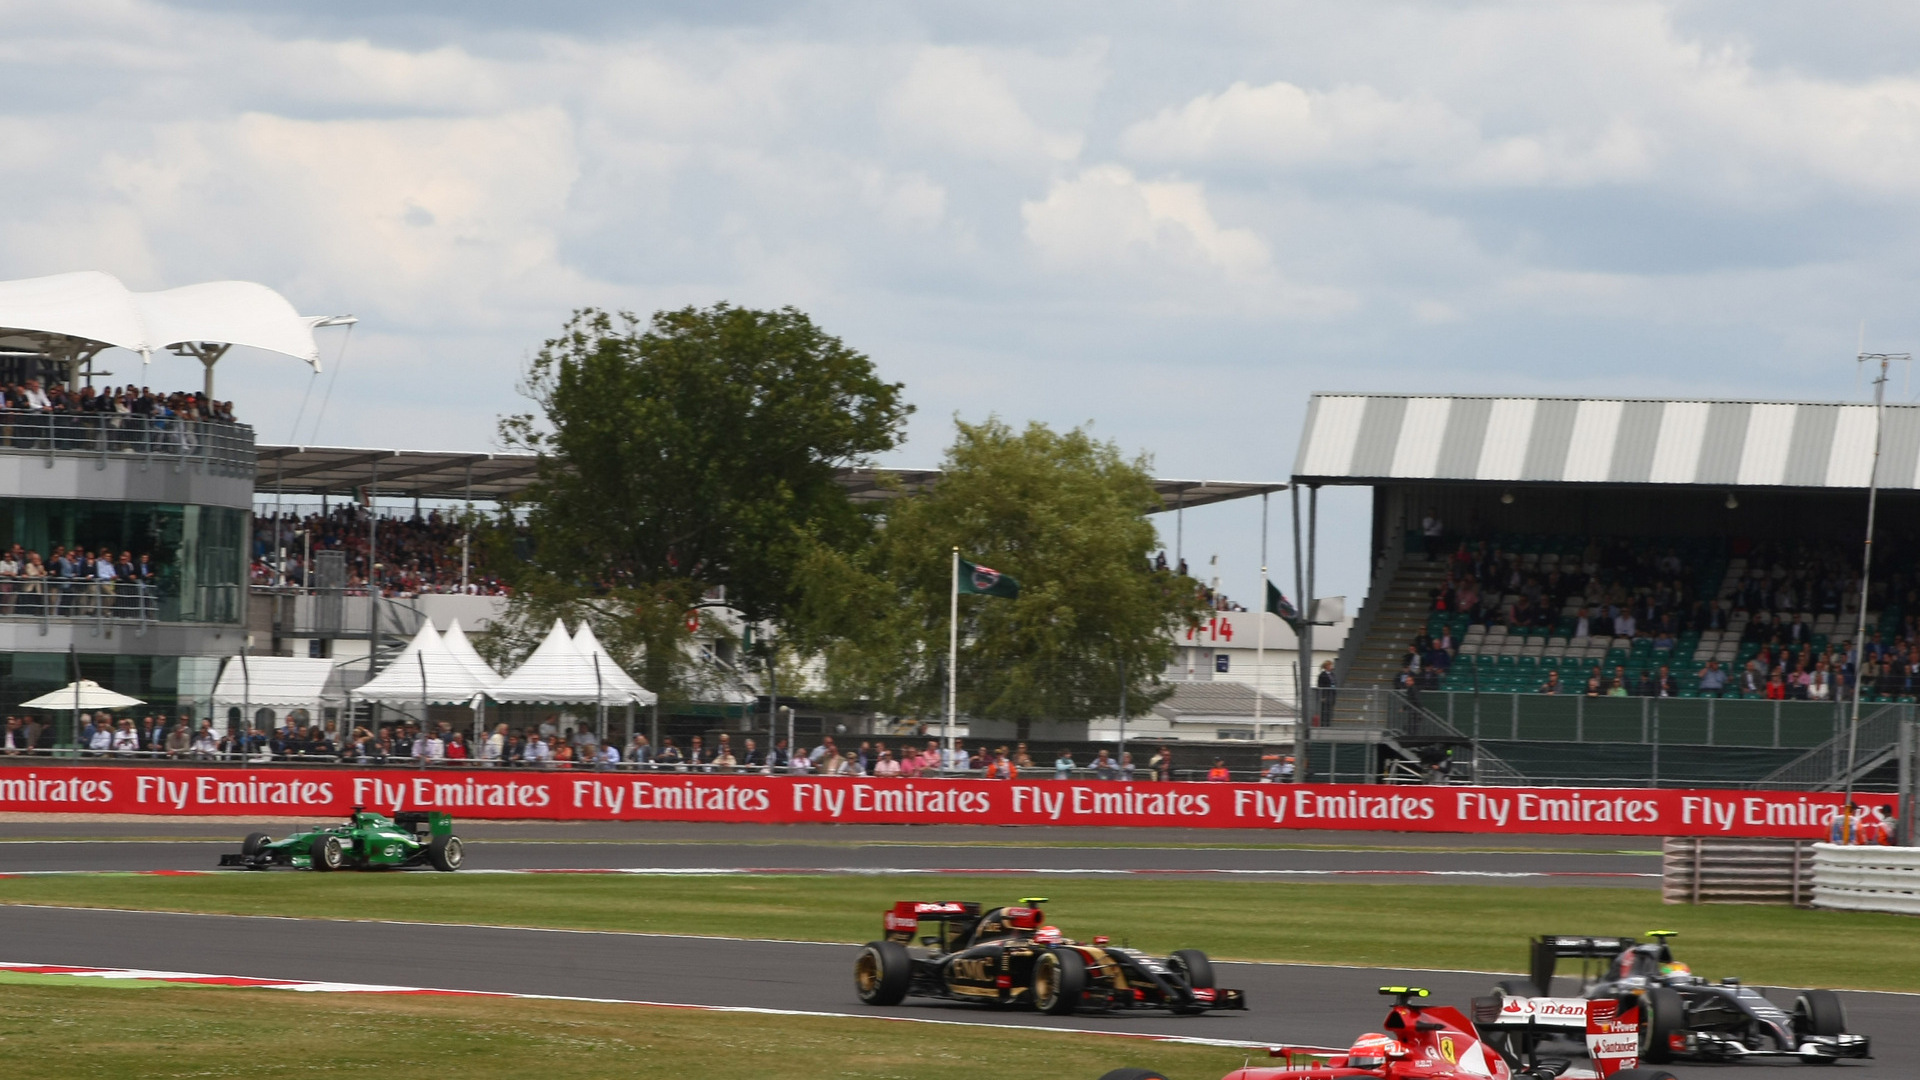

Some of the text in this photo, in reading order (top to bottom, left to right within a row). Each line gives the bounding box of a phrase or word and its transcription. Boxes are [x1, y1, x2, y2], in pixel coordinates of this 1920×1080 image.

[136, 775, 333, 810] Fly Emirates
[353, 777, 550, 812] Fly Emirates
[573, 780, 770, 814] Fly Emirates
[792, 783, 990, 817] Fly Emirates
[1011, 785, 1210, 820] Fly Emirates
[1234, 789, 1435, 824] Fly Emirates
[1456, 792, 1659, 827] Fly Emirates
[1681, 796, 1884, 831] Fly Emiraes
[1524, 1001, 1587, 1016] Sntan
[1610, 1021, 1638, 1032] V-Power
[1602, 1037, 1638, 1053] Santander
